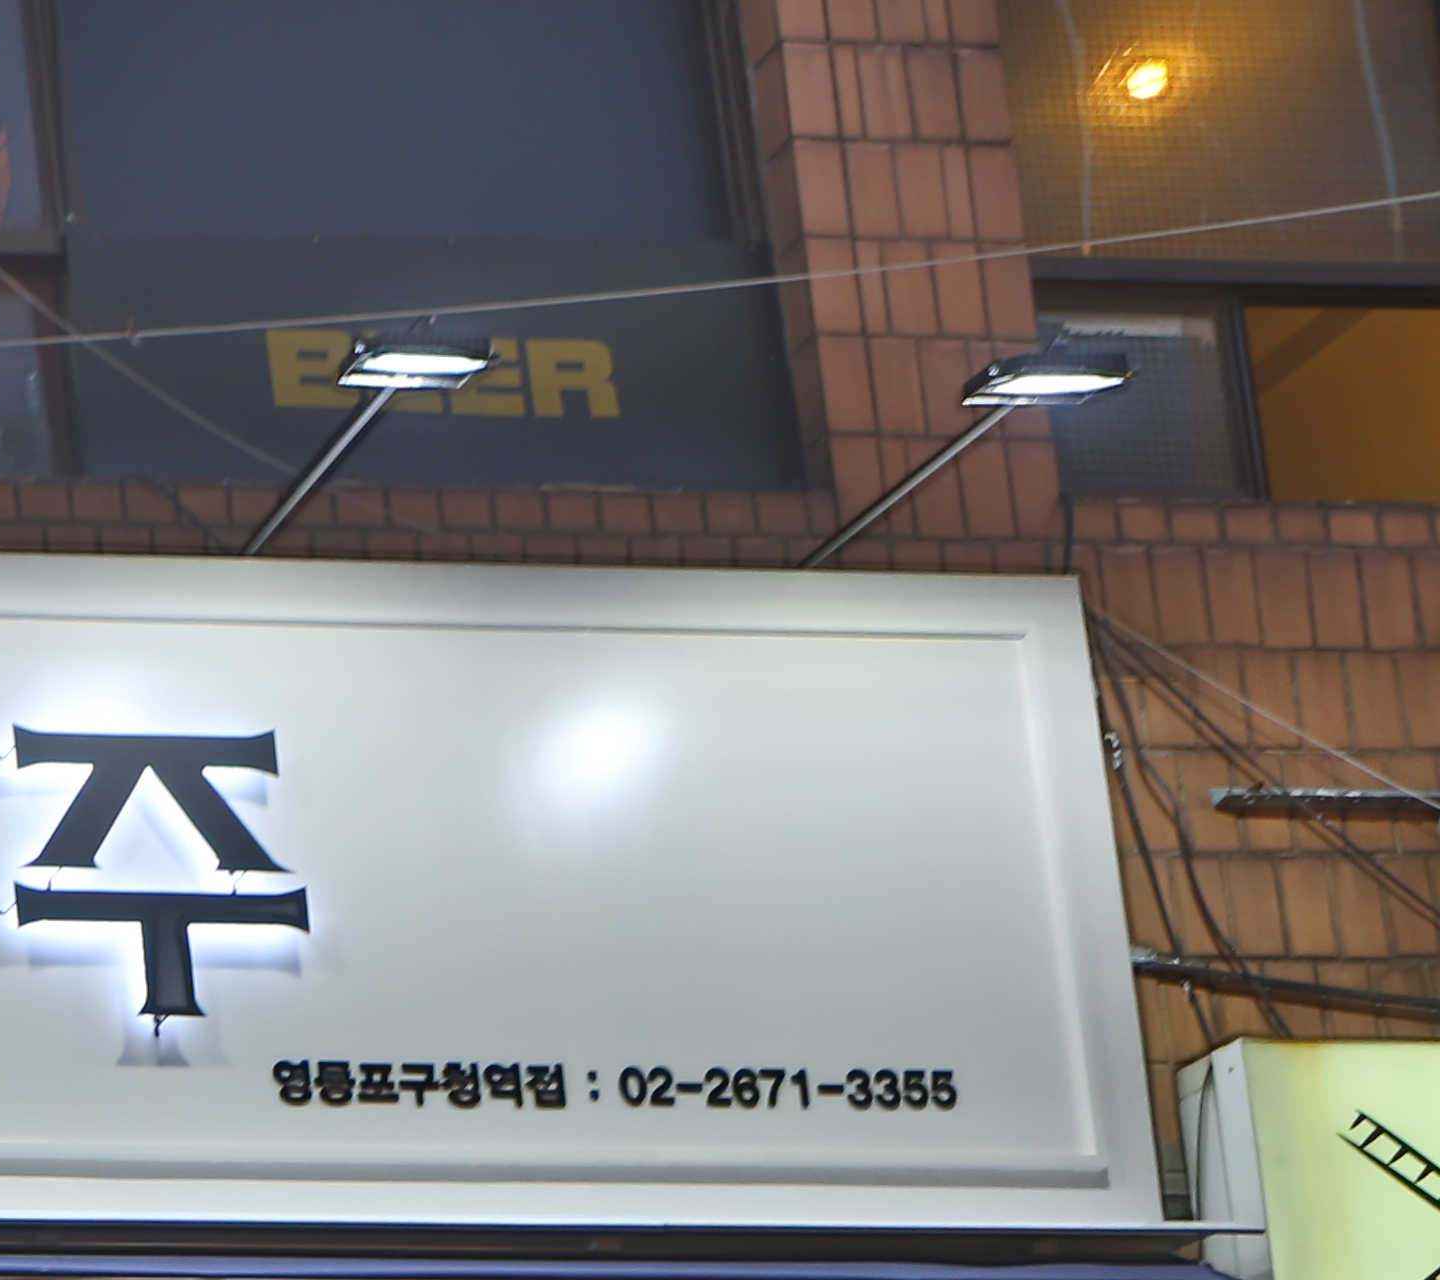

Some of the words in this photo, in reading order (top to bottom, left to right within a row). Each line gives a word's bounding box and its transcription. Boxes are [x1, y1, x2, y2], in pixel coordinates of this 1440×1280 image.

[265, 329, 621, 418] BER
[273, 1060, 566, 1108] 영등포구청역점
[618, 1066, 958, 1110] 02-2671-3355
